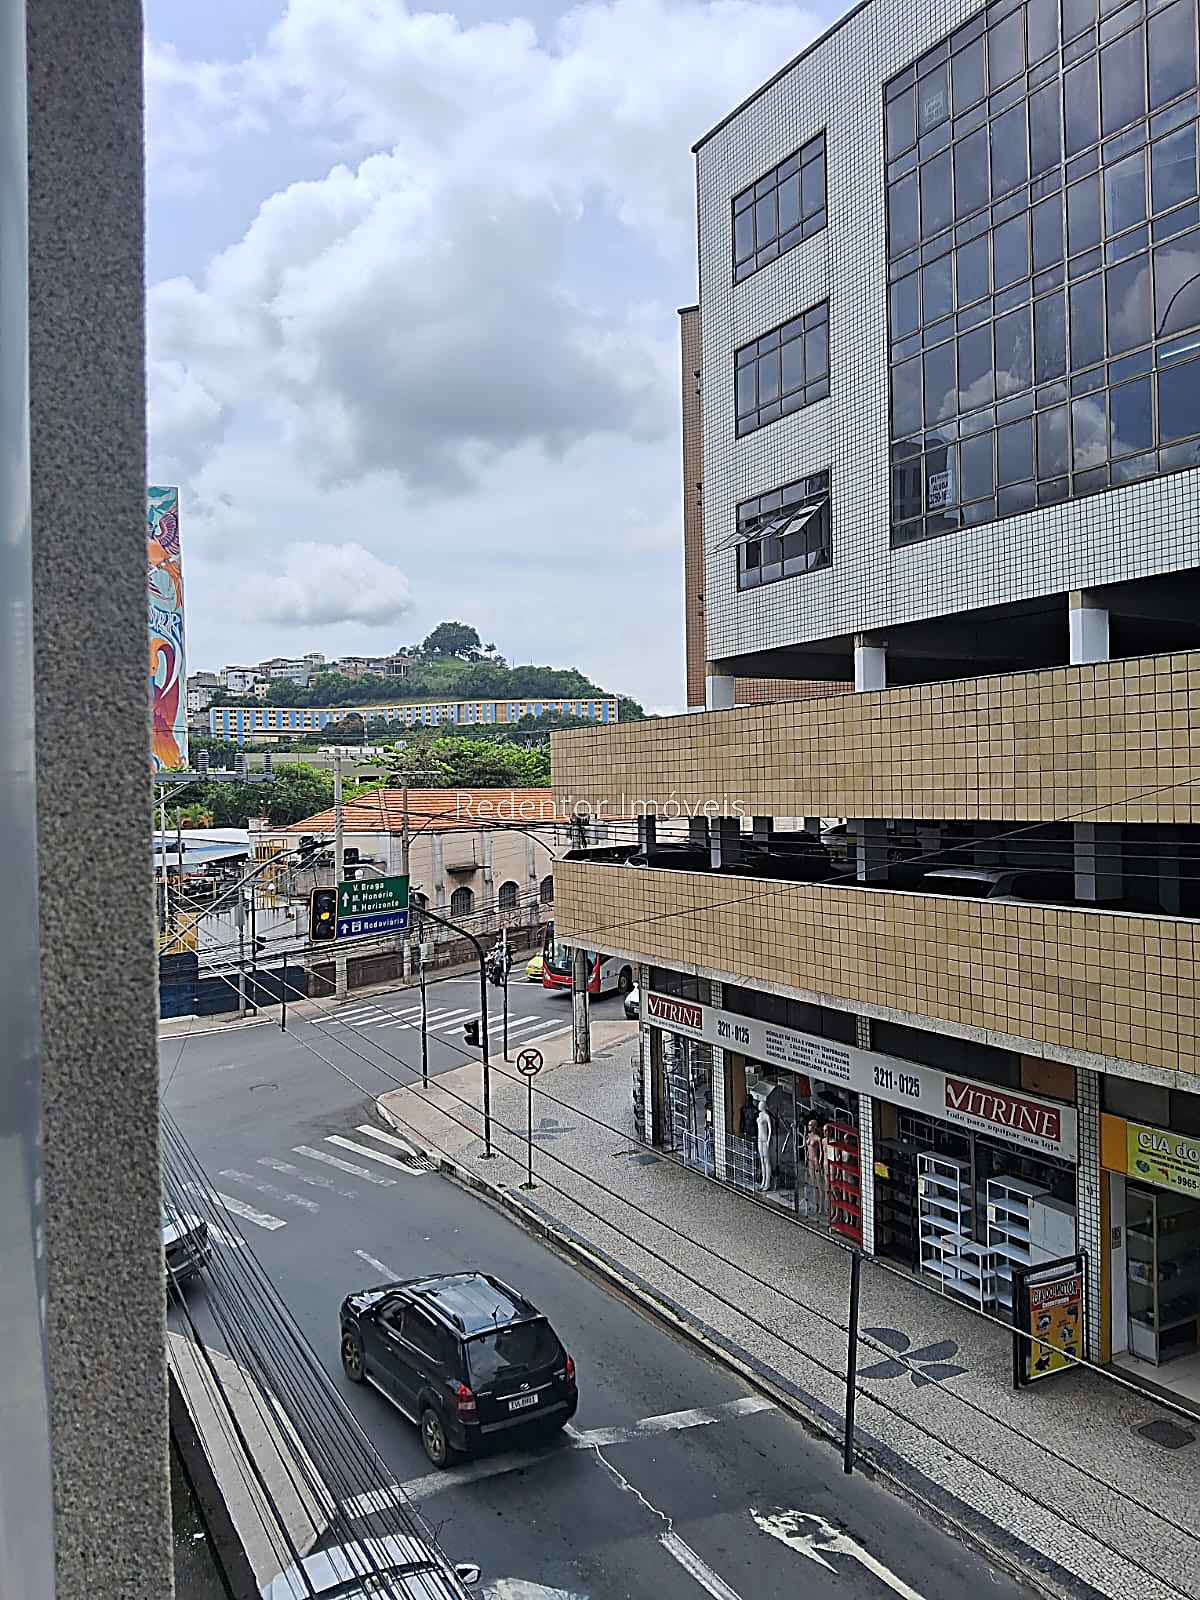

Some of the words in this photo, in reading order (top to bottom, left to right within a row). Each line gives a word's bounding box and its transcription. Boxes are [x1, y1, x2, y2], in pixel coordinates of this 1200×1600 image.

[361, 883, 384, 892] Braga
[361, 900, 399, 912] Horizonte
[363, 918, 404, 930] Rodoviária
[648, 994, 701, 1029] VITRINE
[946, 1083, 1057, 1139] VITRINE
[1138, 1131, 1172, 1155] CIA
[1176, 1141, 1199, 1163] do
